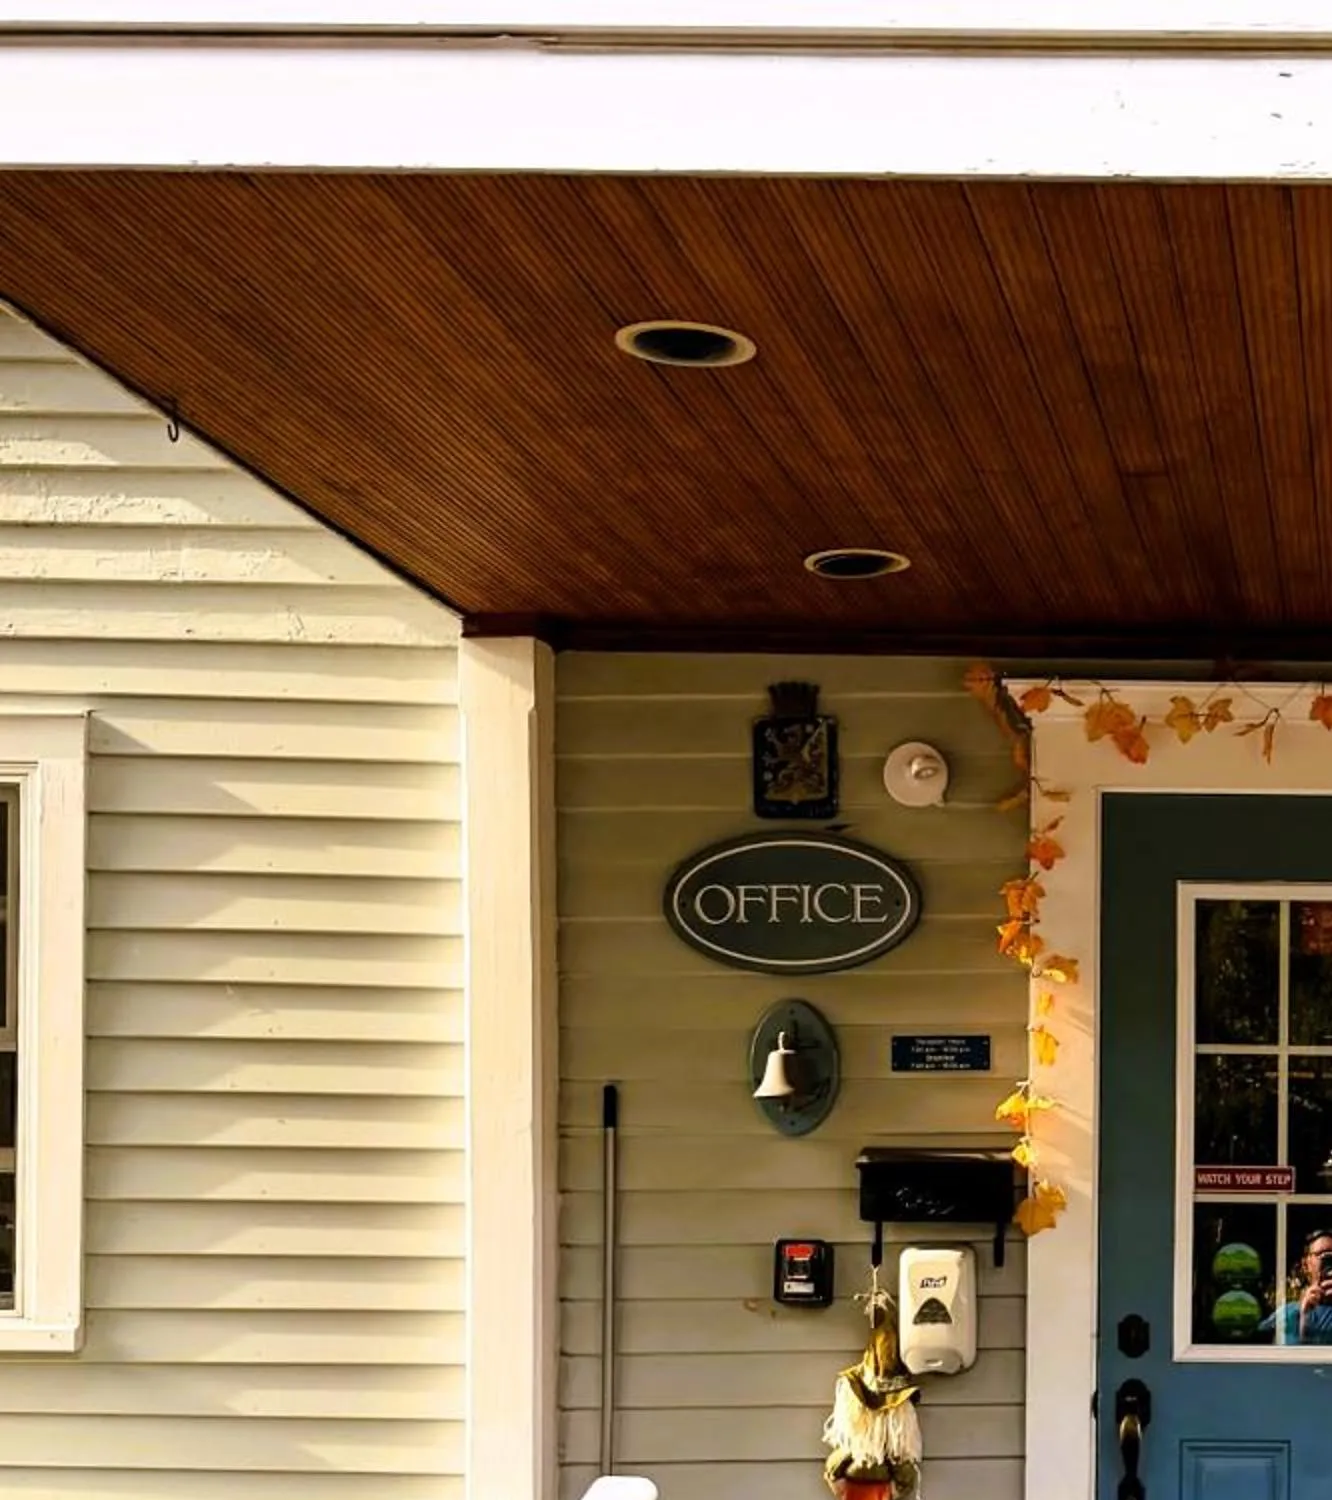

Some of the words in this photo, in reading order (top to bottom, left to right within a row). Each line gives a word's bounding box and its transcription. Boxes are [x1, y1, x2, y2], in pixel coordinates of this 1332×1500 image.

[694, 883, 889, 925] OFFICE
[1197, 1173, 1231, 1185] WATCH
[1235, 1173, 1262, 1185] YOUR
[1265, 1173, 1292, 1185] STEP
